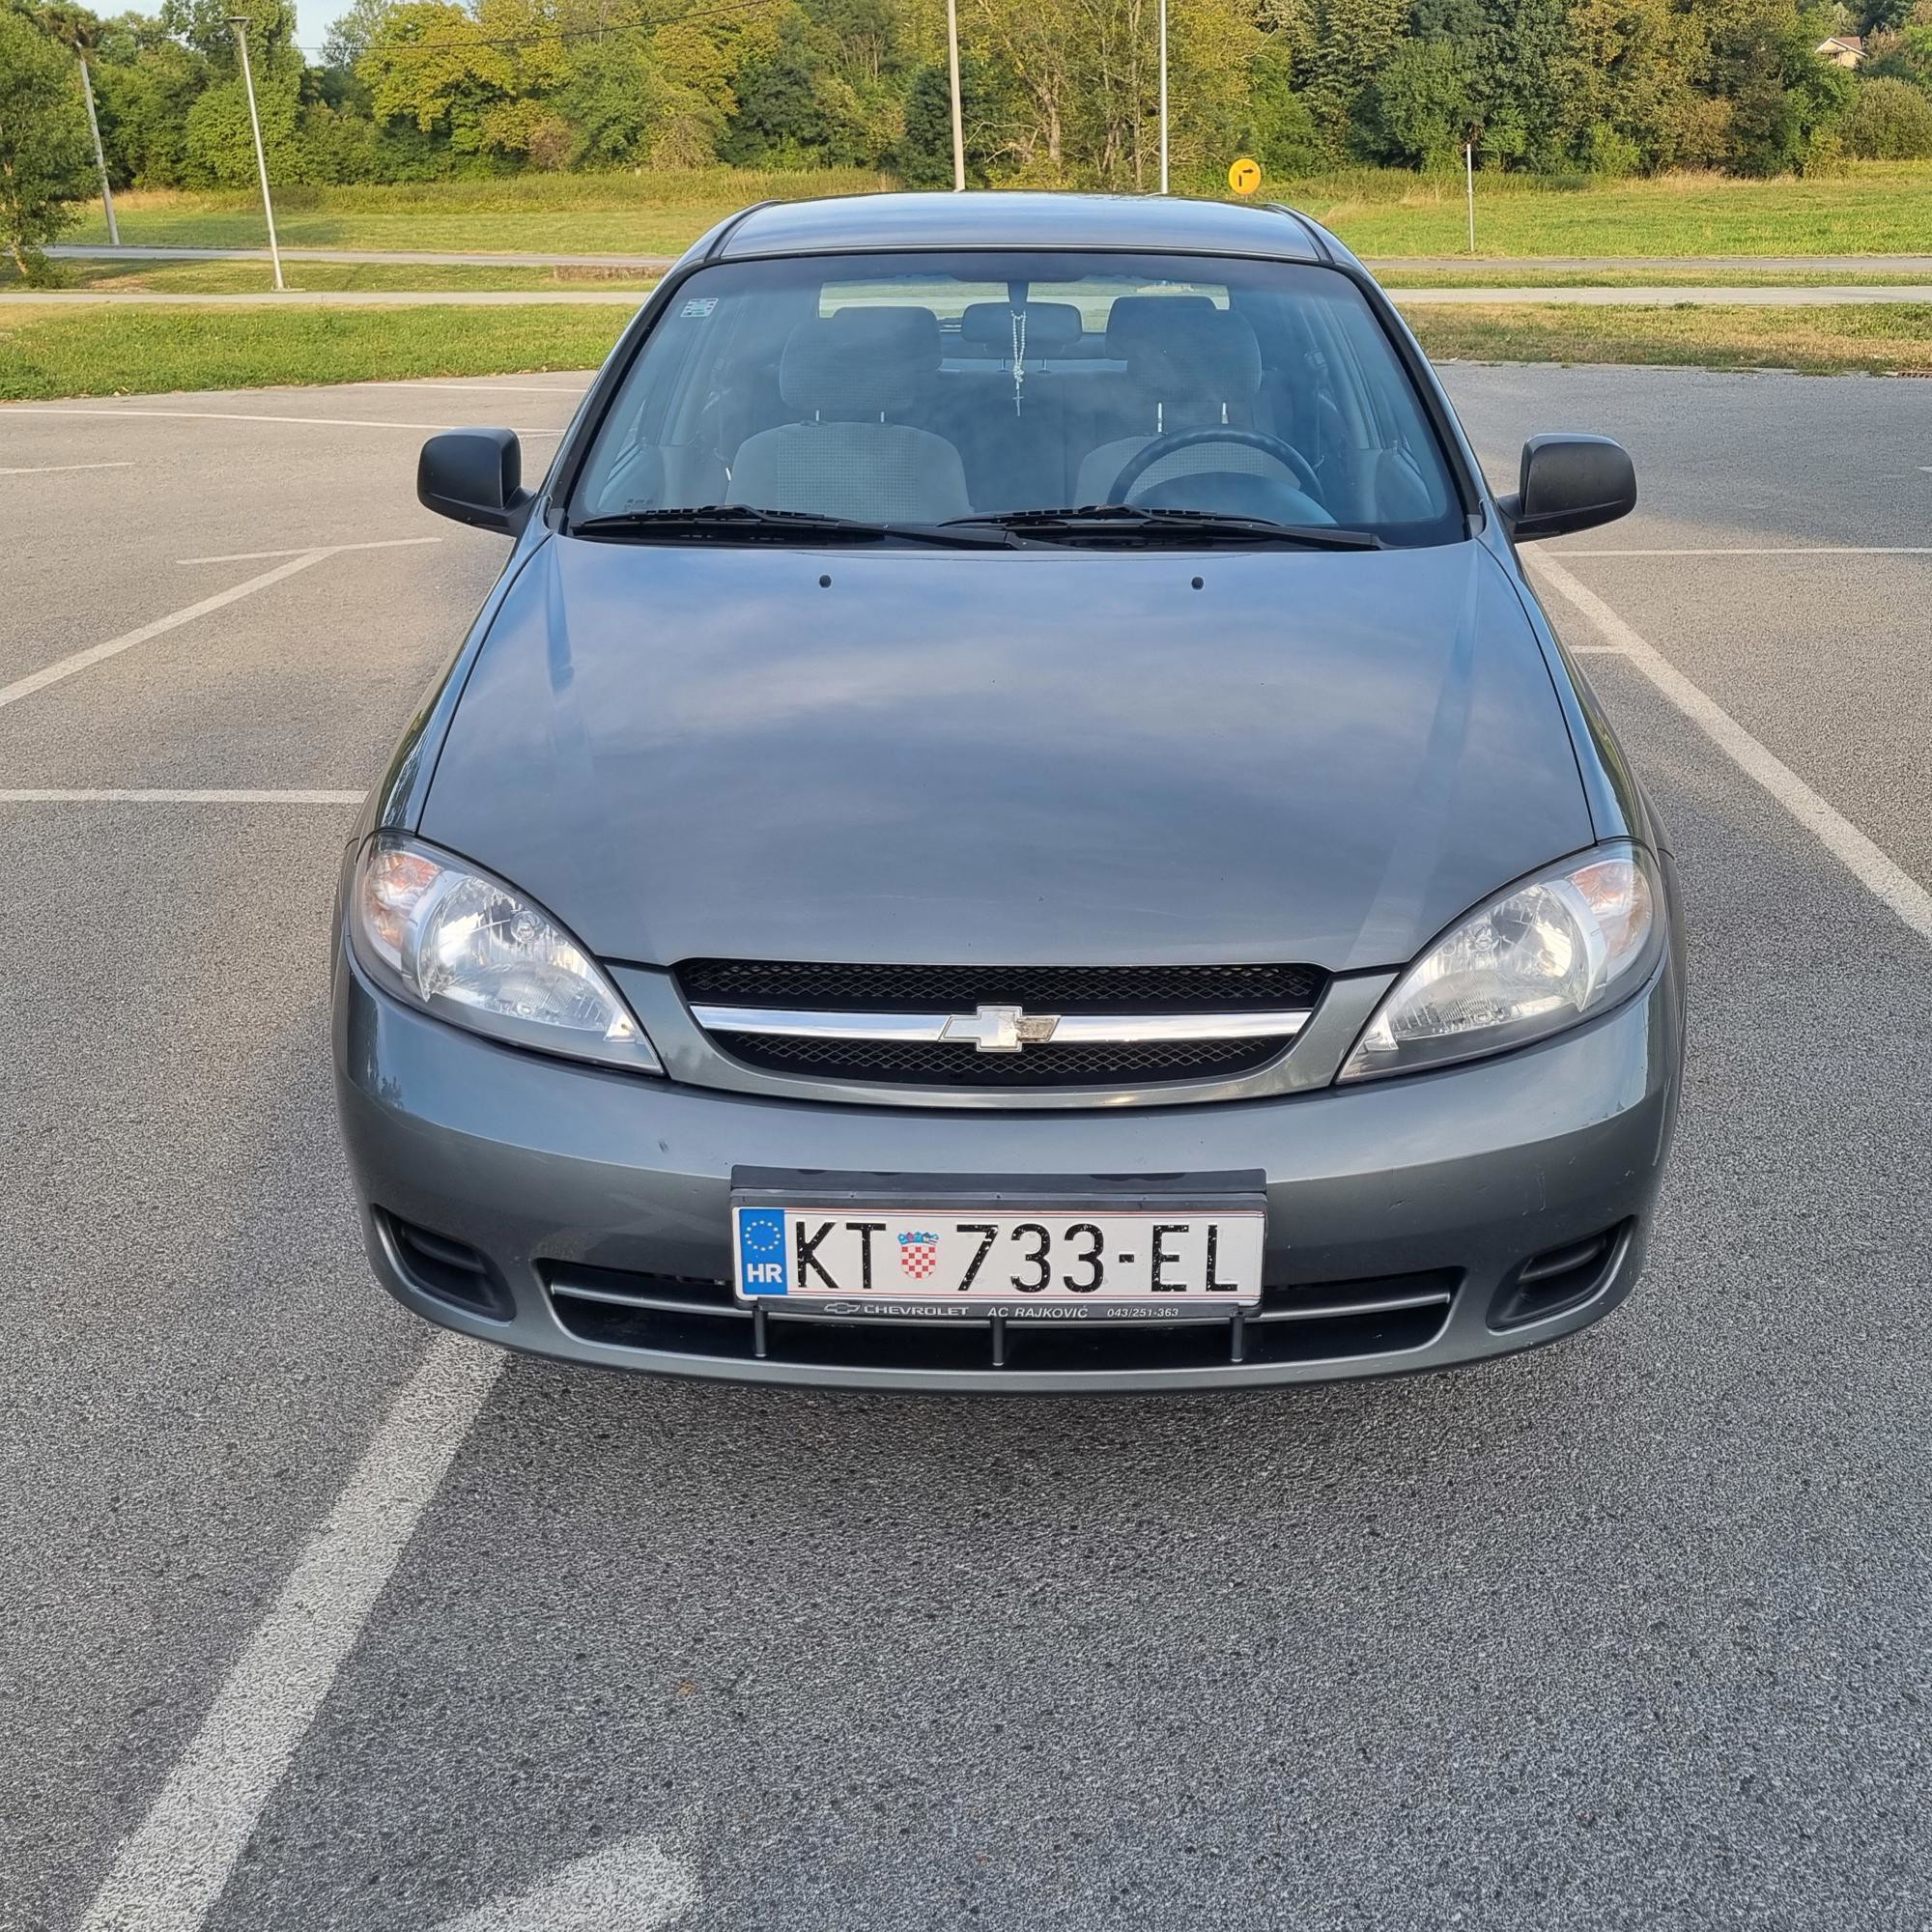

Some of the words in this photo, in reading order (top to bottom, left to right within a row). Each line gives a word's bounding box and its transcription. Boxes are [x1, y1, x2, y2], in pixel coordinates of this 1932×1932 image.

[795, 1221, 887, 1290] KT
[955, 1223, 1238, 1293] 733-EL
[747, 1263, 783, 1284] HR
[863, 1305, 970, 1316] CHEVROLET
[987, 1307, 1009, 1318] AC
[1014, 1305, 1089, 1319] RAJKOVIĆ
[1107, 1308, 1179, 1318] 043/251-363
